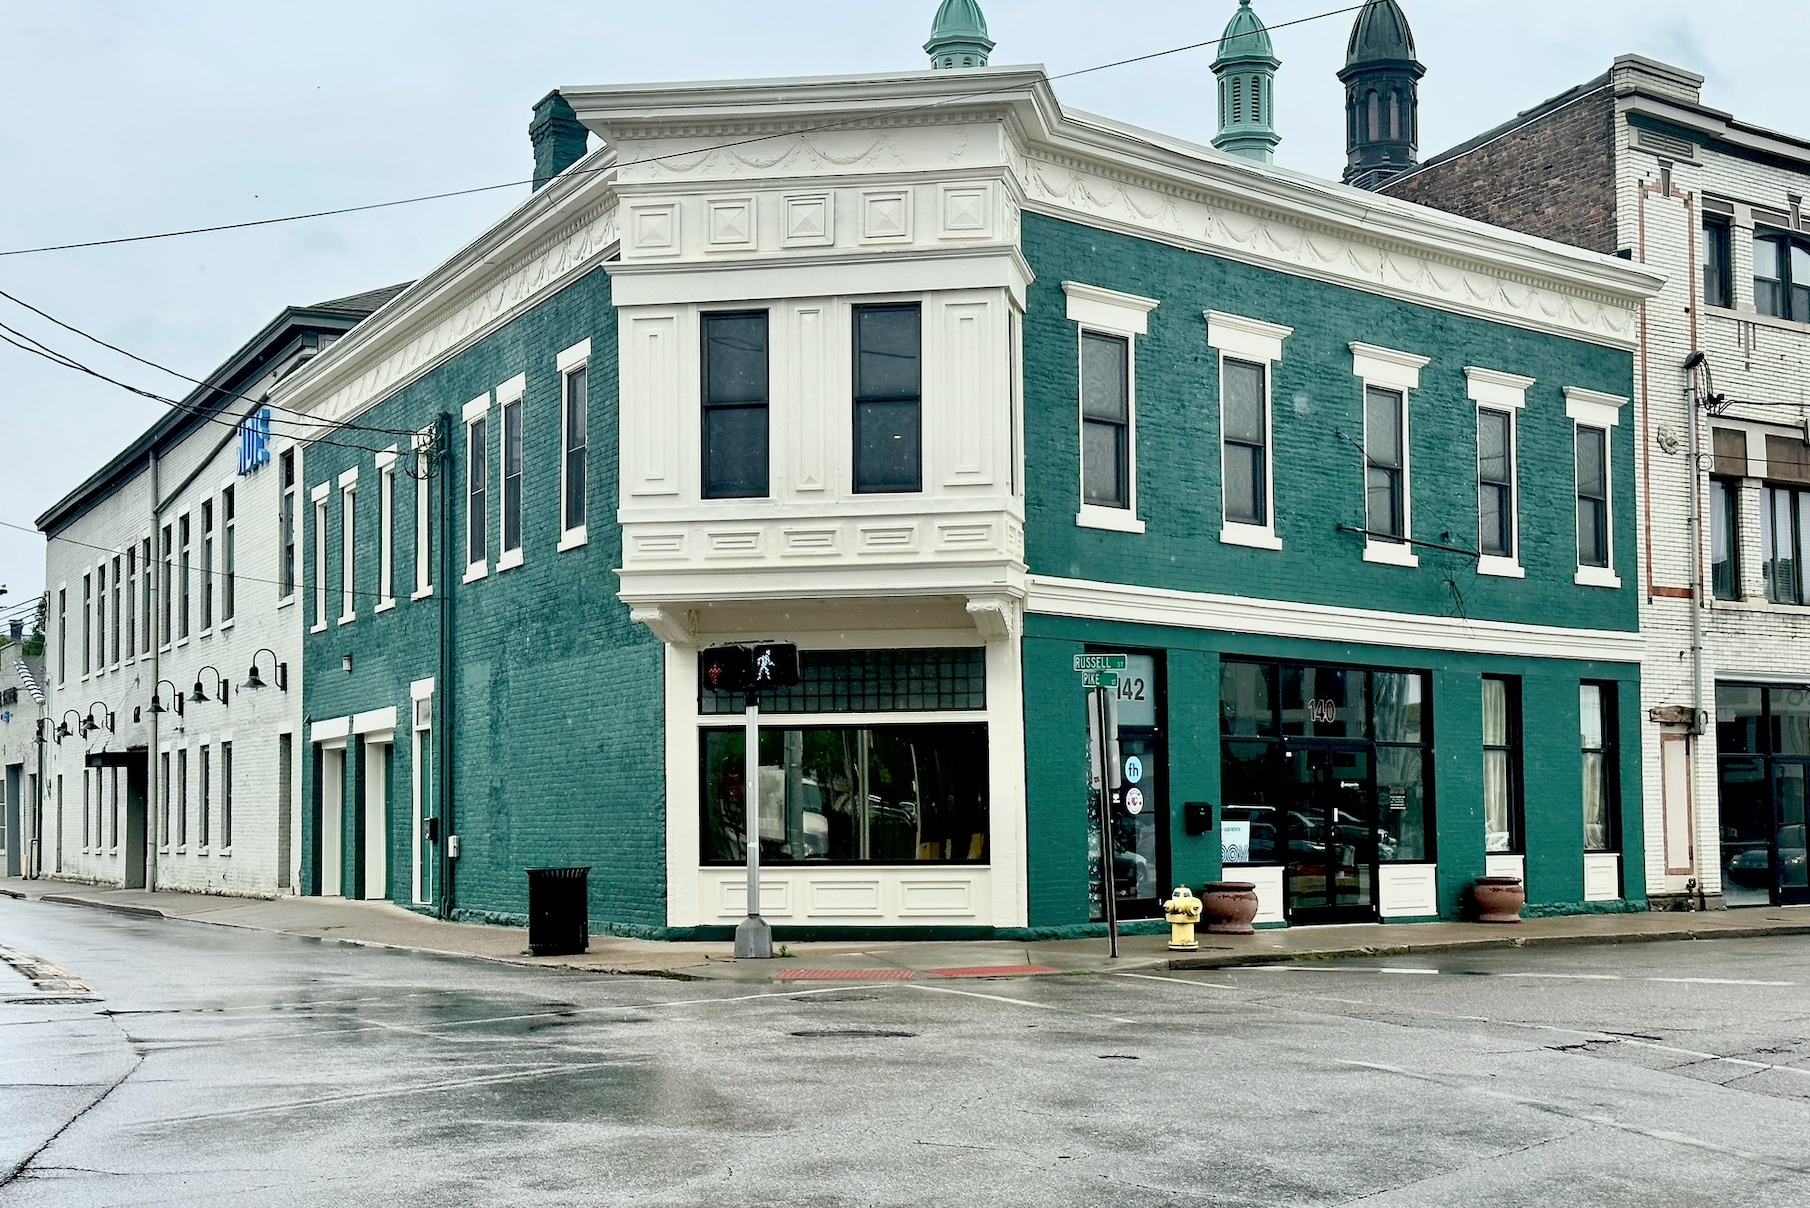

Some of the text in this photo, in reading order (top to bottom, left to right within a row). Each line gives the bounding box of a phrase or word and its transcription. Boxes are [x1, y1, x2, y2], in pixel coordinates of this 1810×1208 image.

[1075, 656, 1111, 669] RUSSELL
[1083, 672, 1100, 685] PIKE
[1117, 677, 1145, 701] 142
[1308, 699, 1336, 723] 140
[1128, 762, 1139, 777] fh
